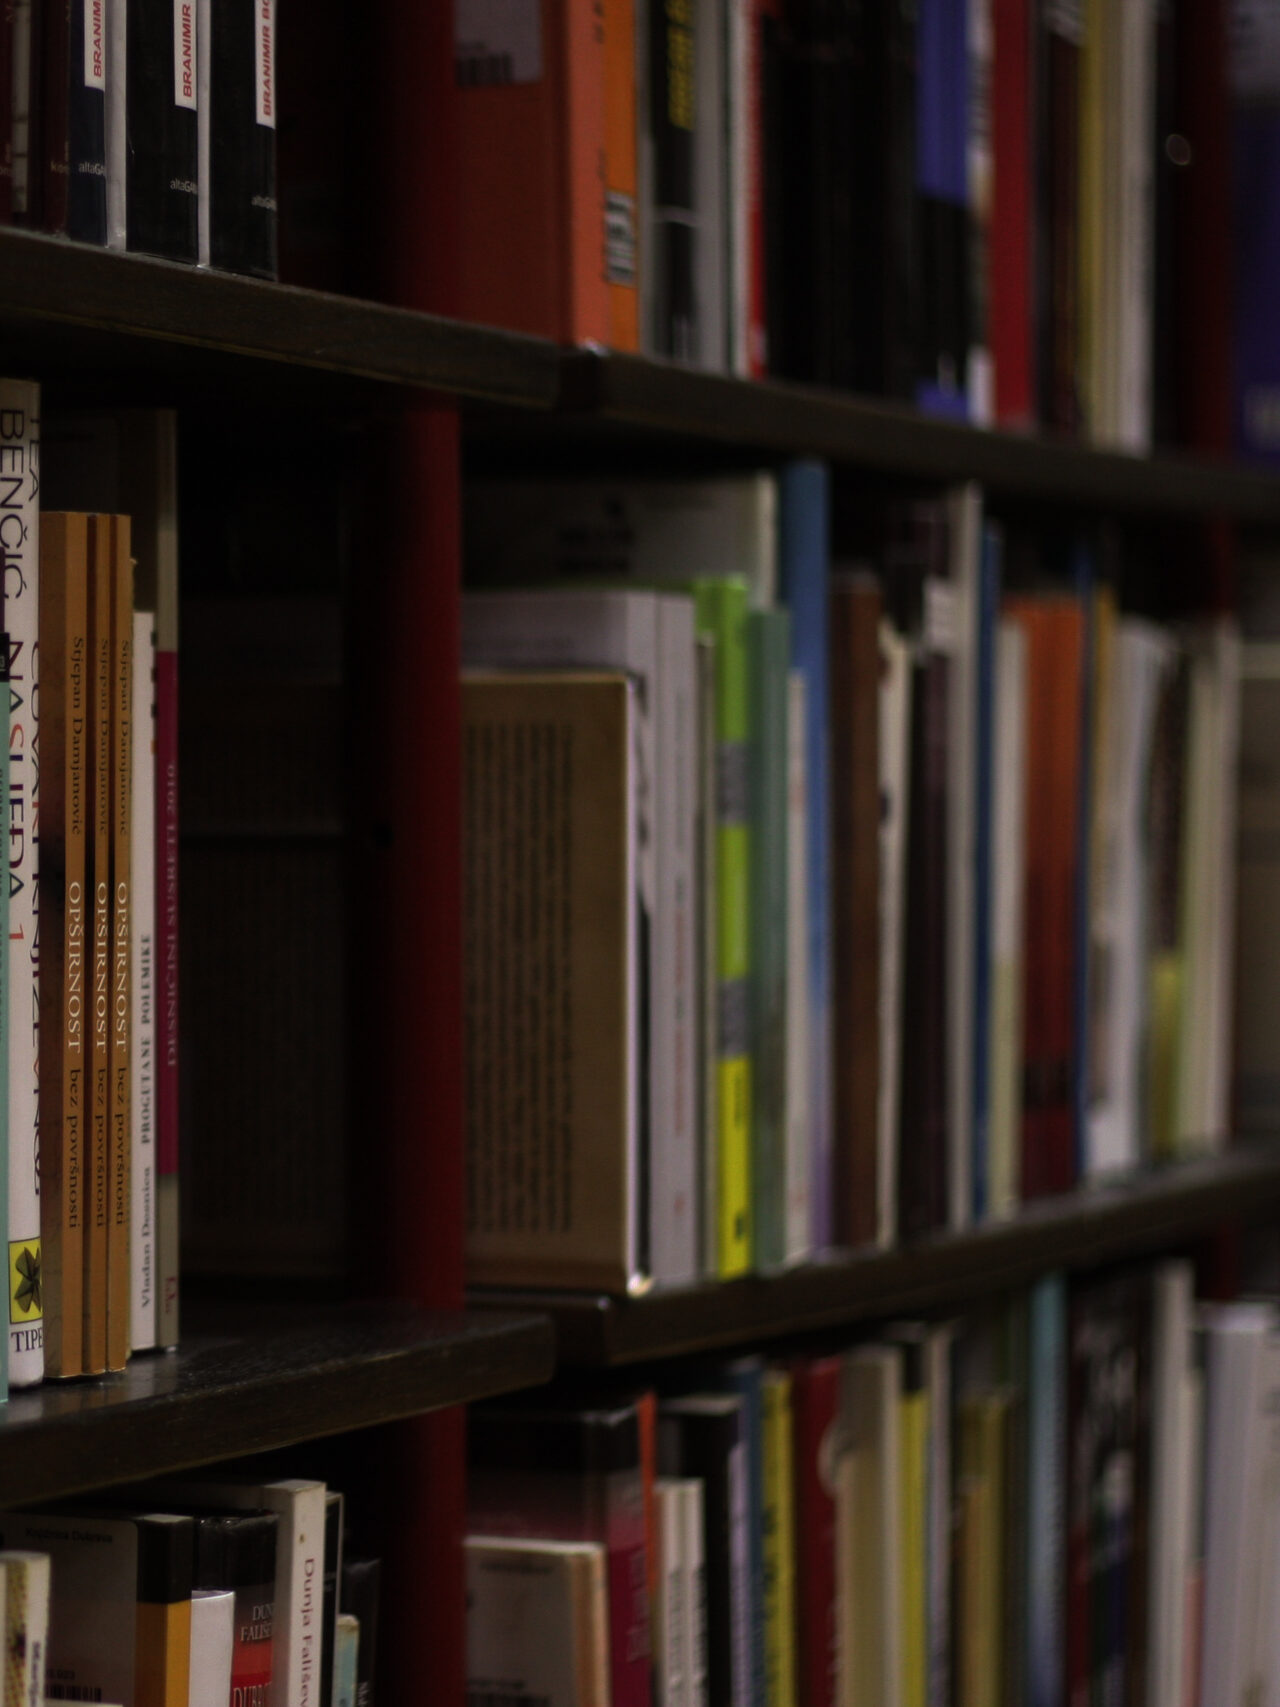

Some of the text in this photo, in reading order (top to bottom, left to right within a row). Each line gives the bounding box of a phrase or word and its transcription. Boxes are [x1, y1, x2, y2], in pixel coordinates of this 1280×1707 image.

[182, 4, 192, 97] BRANIMIR
[262, 26, 271, 116] BRANIMIR
[66, 637, 84, 1229] Stjepan Damjanović OPŠIRNOST bez površnosti
[95, 638, 109, 1228] Stjepan Damjanović OPŠIRNOST bez površnosti
[114, 639, 129, 1225] Stjepan Damjanović OPŠIRNOST bez površnosti
[167, 823, 177, 927] SUSRETI
[140, 934, 151, 1308] Vladan Desnica PROGUTANE POLEMIKE
[301, 1558, 314, 1627] Dunja
